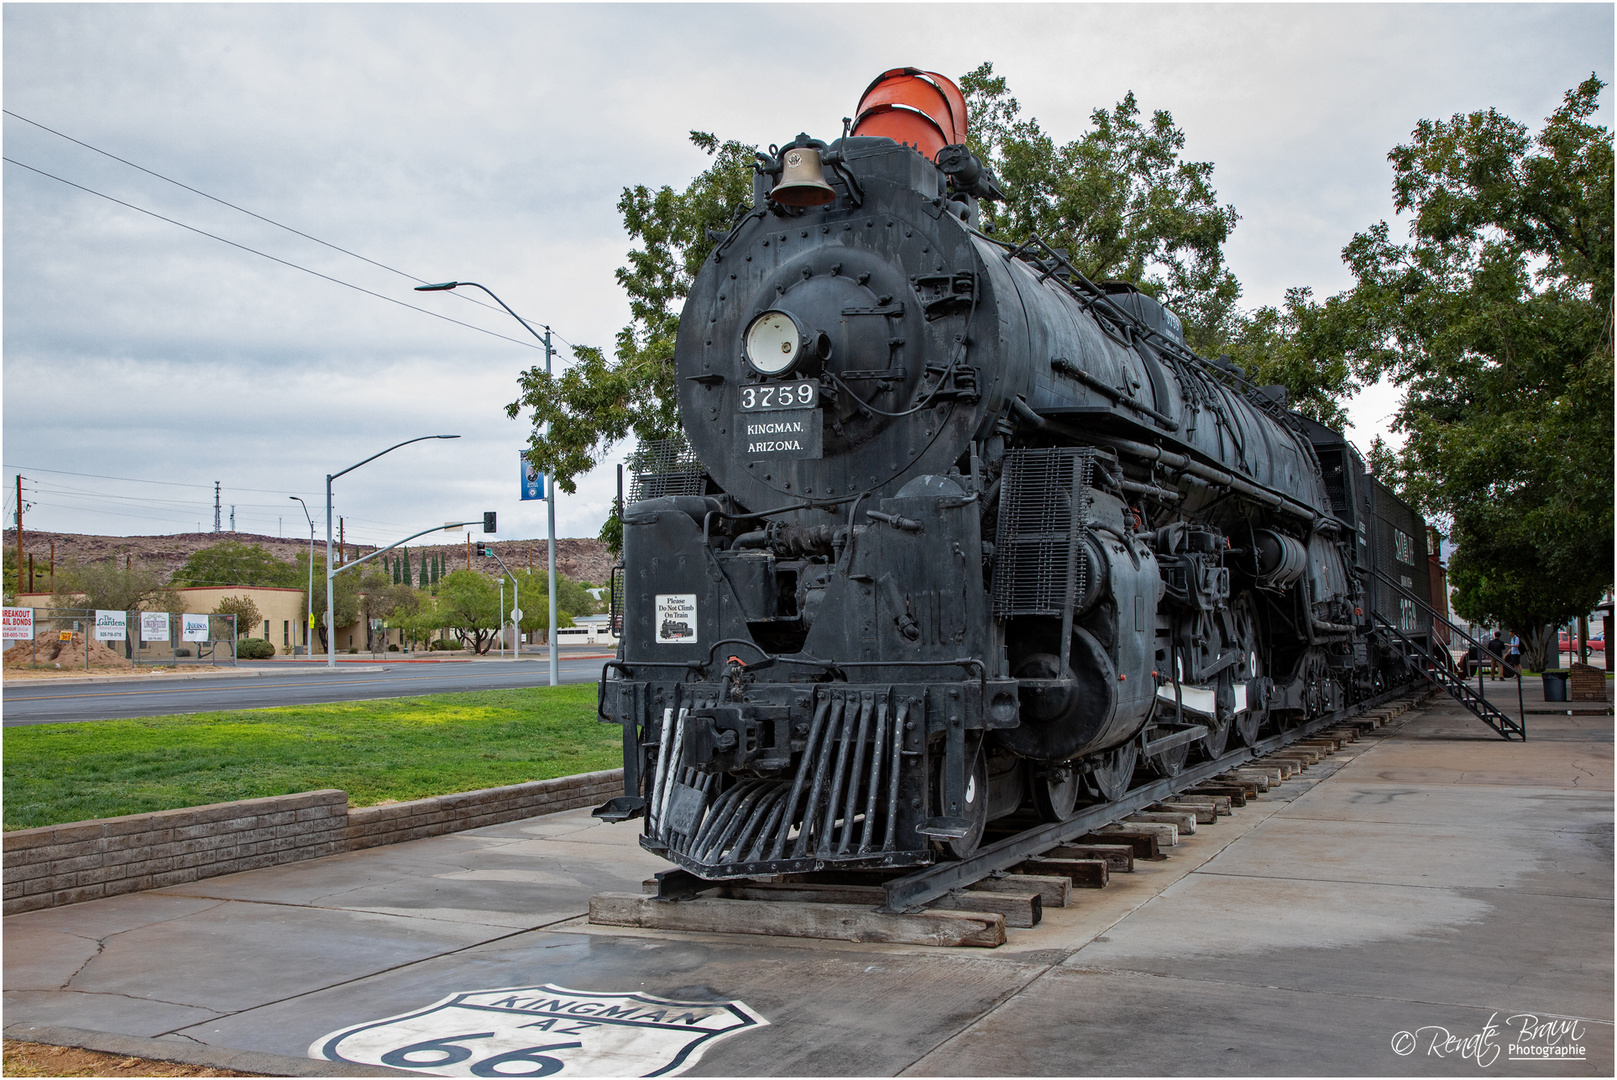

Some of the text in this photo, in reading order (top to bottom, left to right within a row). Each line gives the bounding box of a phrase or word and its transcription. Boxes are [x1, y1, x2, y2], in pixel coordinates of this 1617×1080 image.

[742, 384, 813, 409] 3759
[747, 422, 804, 435] KINGMAN,
[747, 440, 804, 453] ARIZONA.
[2, 618, 32, 626] AIL BONDS
[97, 617, 125, 626] Gardens
[497, 995, 715, 1025] KINGMAN
[516, 1018, 603, 1035] AZ
[380, 1032, 582, 1077] 66
